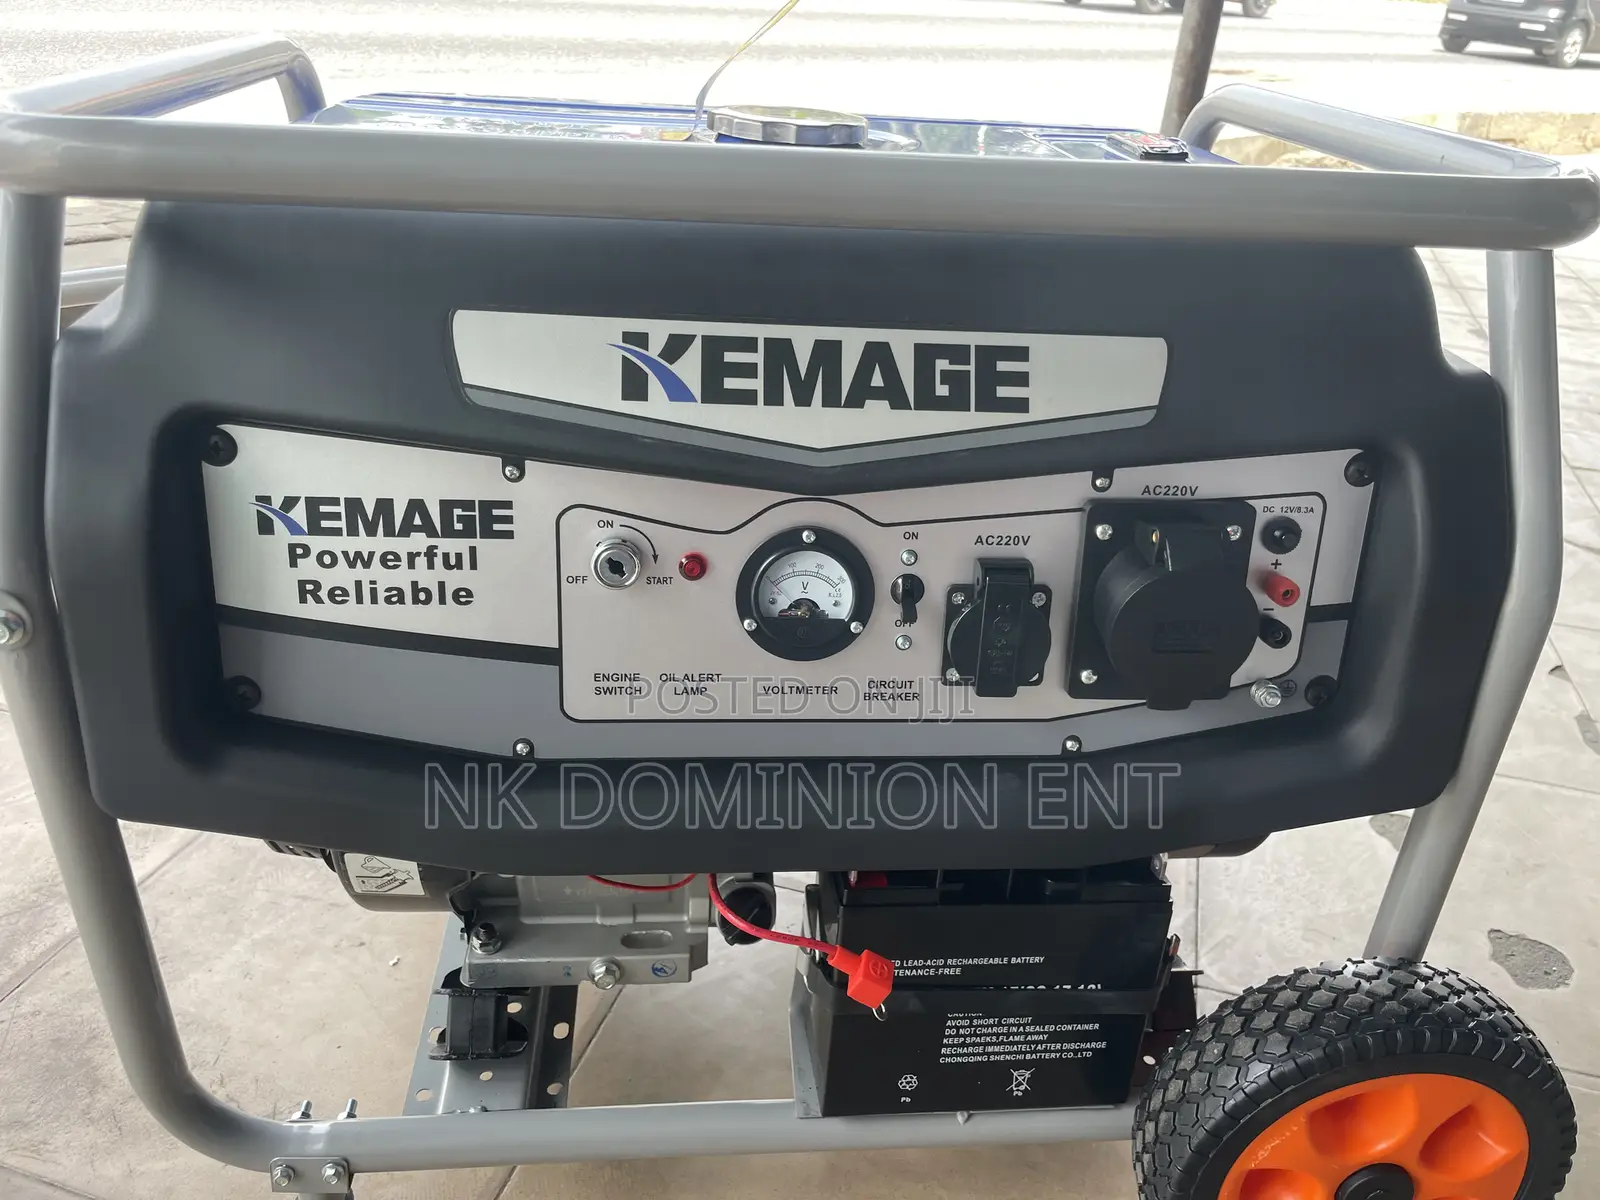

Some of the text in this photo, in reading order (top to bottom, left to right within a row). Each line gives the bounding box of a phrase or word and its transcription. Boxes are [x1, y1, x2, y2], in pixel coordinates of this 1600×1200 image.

[606, 331, 1030, 414] KEMAGE
[1141, 485, 1199, 497] AC220V
[1280, 506, 1315, 514] 12V/8.3A
[248, 495, 515, 540] KEMAGE
[597, 520, 614, 528] ON
[903, 531, 919, 540] ON
[974, 535, 1031, 546] AC220V
[287, 543, 478, 571] Powerful
[566, 575, 588, 584] OFF
[646, 576, 673, 584] START
[297, 579, 474, 605] Reliable
[593, 673, 641, 682] ENGINE
[659, 673, 722, 683] OIL ALERT
[763, 685, 838, 695] VOLTMETER
[867, 680, 915, 690] CIRCUIT
[594, 686, 642, 696] SWITCH
[673, 686, 708, 696] LAMP
[863, 692, 920, 701] BREAKER
[903, 958, 945, 967] LEAD-ACID
[946, 957, 1008, 966] RECHARGEABLE
[1010, 956, 1045, 964] BATTERY
[894, 967, 962, 977] TENANCE-FREE
[946, 1016, 1033, 1027] AVOID SHORT CIRCUIT
[945, 1028, 957, 1036] DO
[959, 1027, 976, 1035] NOT
[976, 1026, 1009, 1034] CHARGE
[1025, 1024, 1055, 1032] SEALED
[1056, 1023, 1100, 1031] CONTAINER
[942, 1037, 965, 1045] KEEP
[1026, 1033, 1049, 1041] AWAY
[941, 1041, 1107, 1055] RECHARGE IMMEDIATELY AFTER DISCHARGE
[940, 1055, 988, 1064] CHONGQING
[989, 1053, 1025, 1061] SHENCHI
[1025, 1052, 1061, 1060] BATTERY
